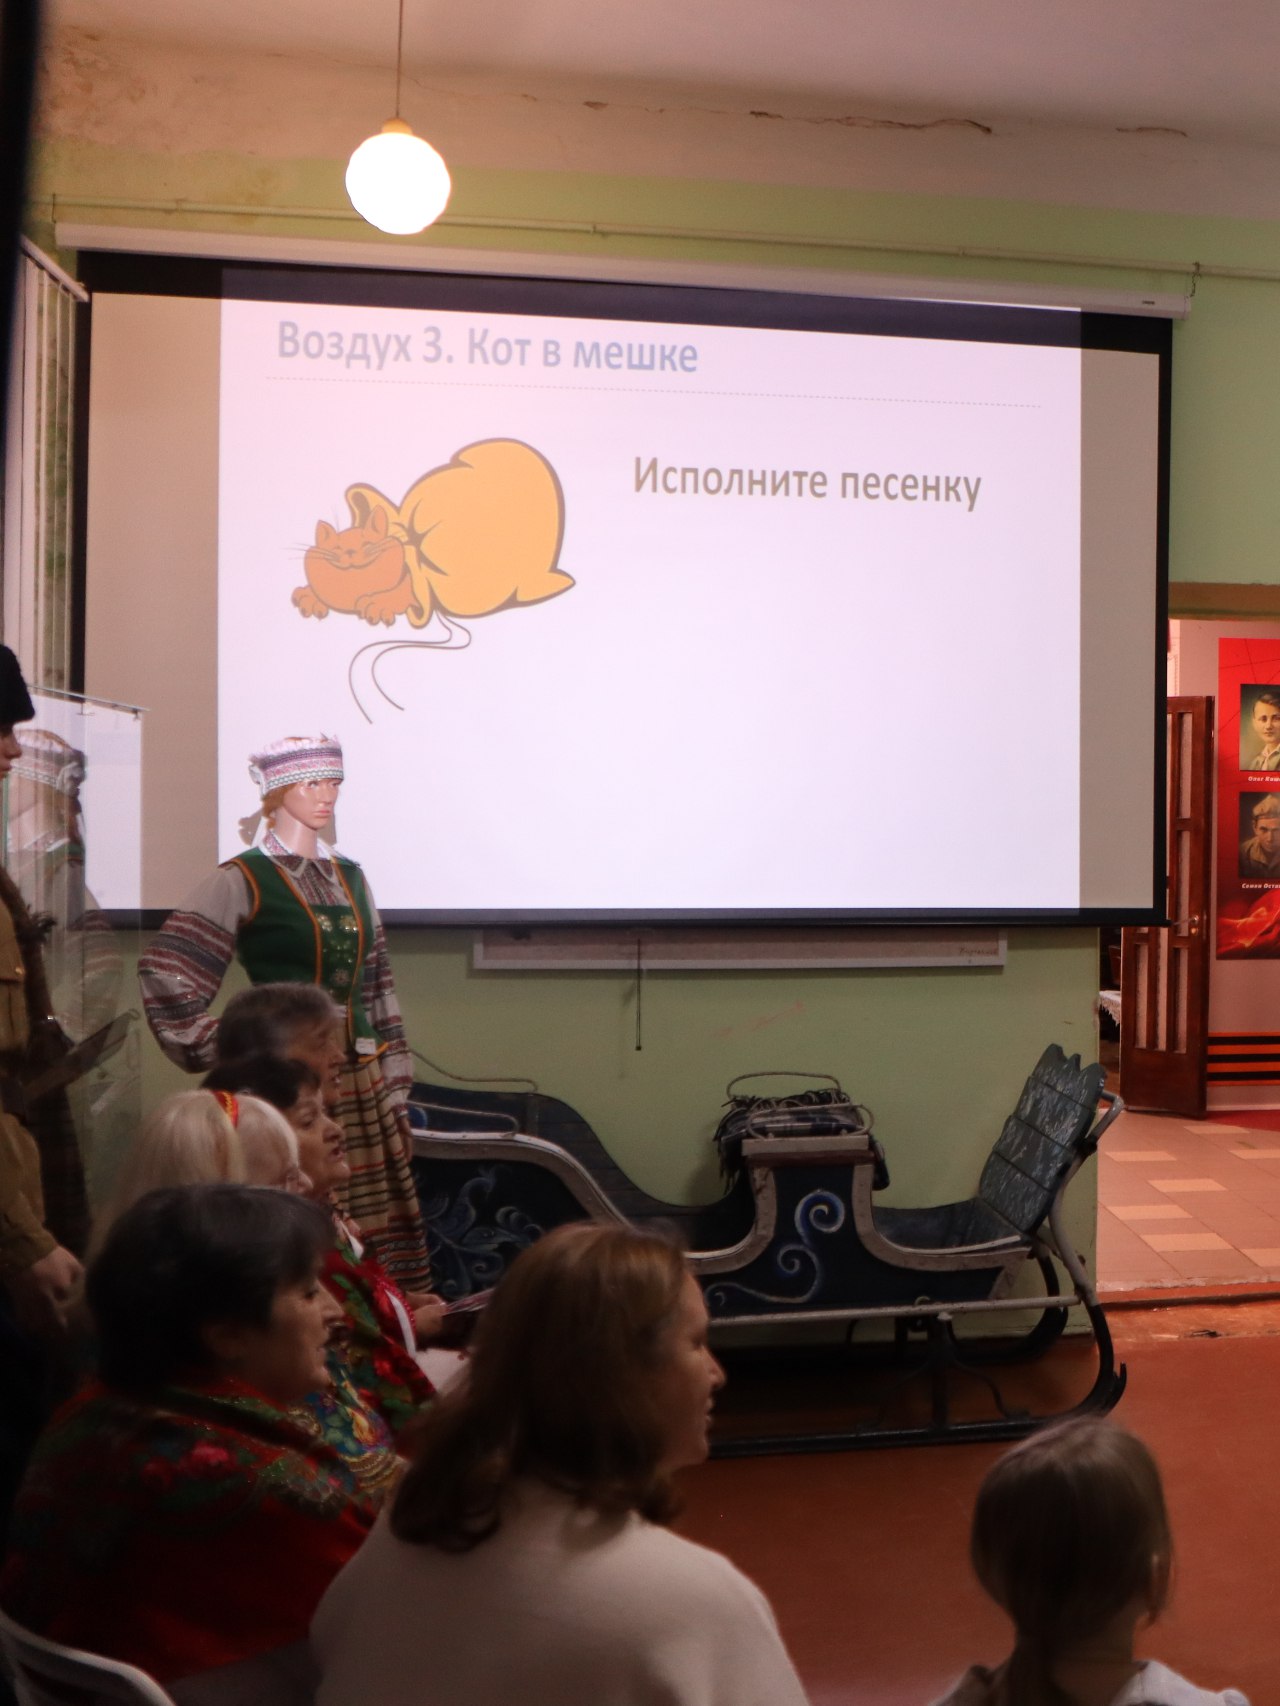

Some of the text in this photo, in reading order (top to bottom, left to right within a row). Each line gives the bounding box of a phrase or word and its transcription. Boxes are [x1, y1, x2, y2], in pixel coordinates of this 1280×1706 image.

[277, 320, 698, 372] Воздух 3. Кот в мешке
[634, 456, 982, 512] Исполните песенку
